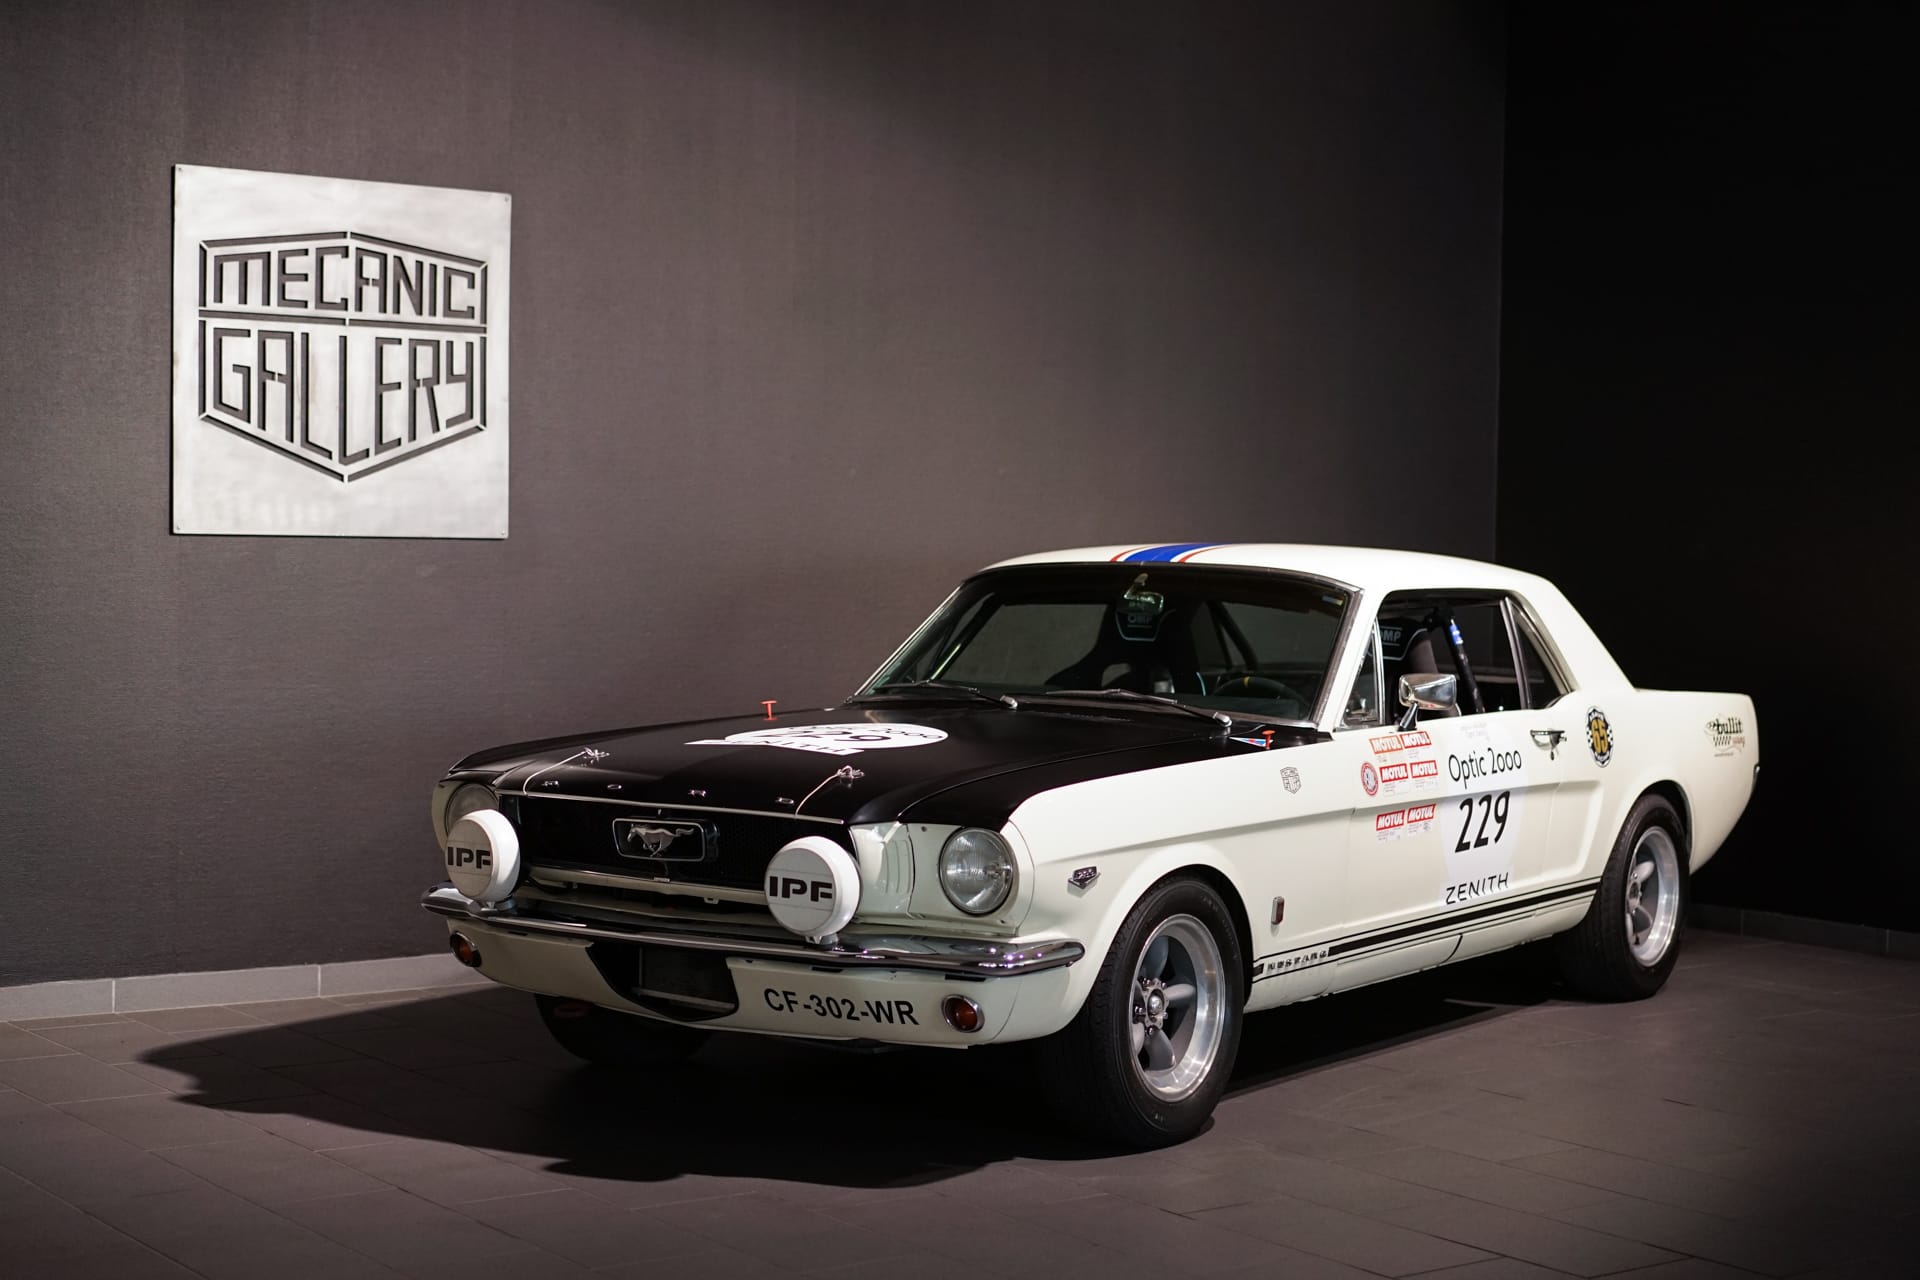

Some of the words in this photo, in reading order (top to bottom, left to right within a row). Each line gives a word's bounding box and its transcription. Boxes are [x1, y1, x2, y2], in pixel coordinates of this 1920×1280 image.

[213, 245, 475, 319] MECANIC
[212, 327, 474, 466] GALLERY
[1371, 736, 1402, 753] MOTUL
[1401, 731, 1431, 748] MOTUL
[1591, 717, 1609, 754] 65
[1715, 717, 1743, 735] bullit
[1381, 764, 1409, 782] MOTUL
[1411, 761, 1438, 778] MOTUL
[1448, 751, 1487, 789] Optic
[1377, 812, 1404, 829] MOTUL
[1408, 806, 1435, 823] MOTUL
[1454, 790, 1511, 854] 229
[447, 847, 493, 870] IPF
[768, 876, 833, 903] IPF
[1445, 872, 1509, 905] ZENITH
[763, 987, 921, 1026] CF-302-WR
